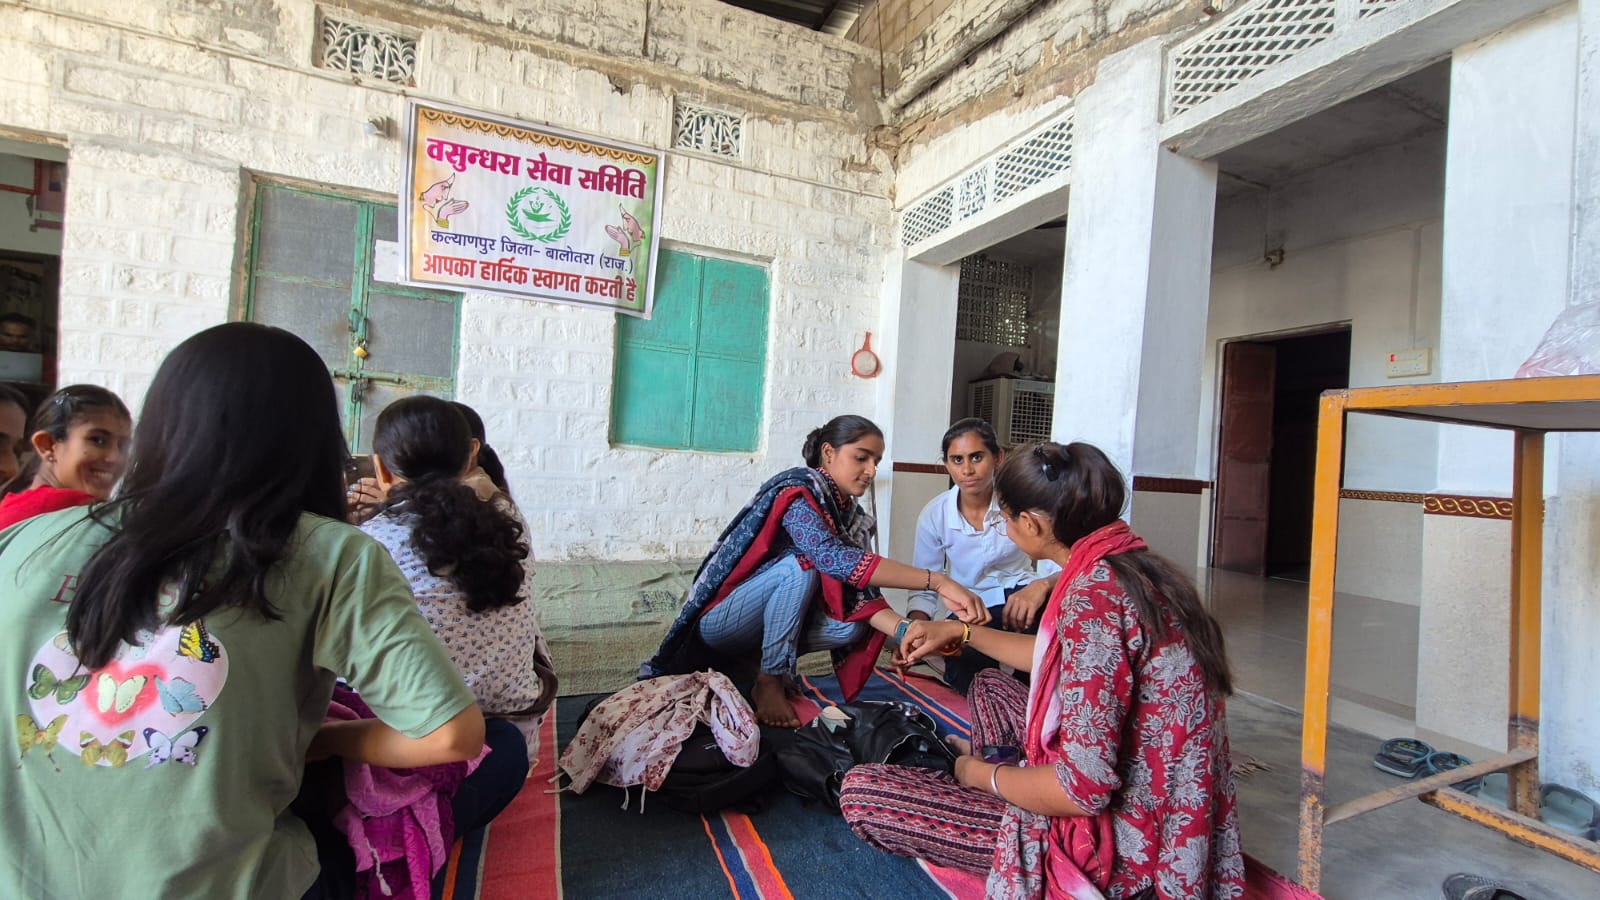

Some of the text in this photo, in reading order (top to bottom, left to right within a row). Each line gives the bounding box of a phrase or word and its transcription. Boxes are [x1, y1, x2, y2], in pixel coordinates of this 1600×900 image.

[426, 138, 646, 199] वसुन्धरा सेवा समिति
[431, 230, 497, 255] कल्याणपुर
[545, 245, 595, 266] बालोतरा
[423, 253, 637, 301] आपका हार्दिक स्वागत करती है
